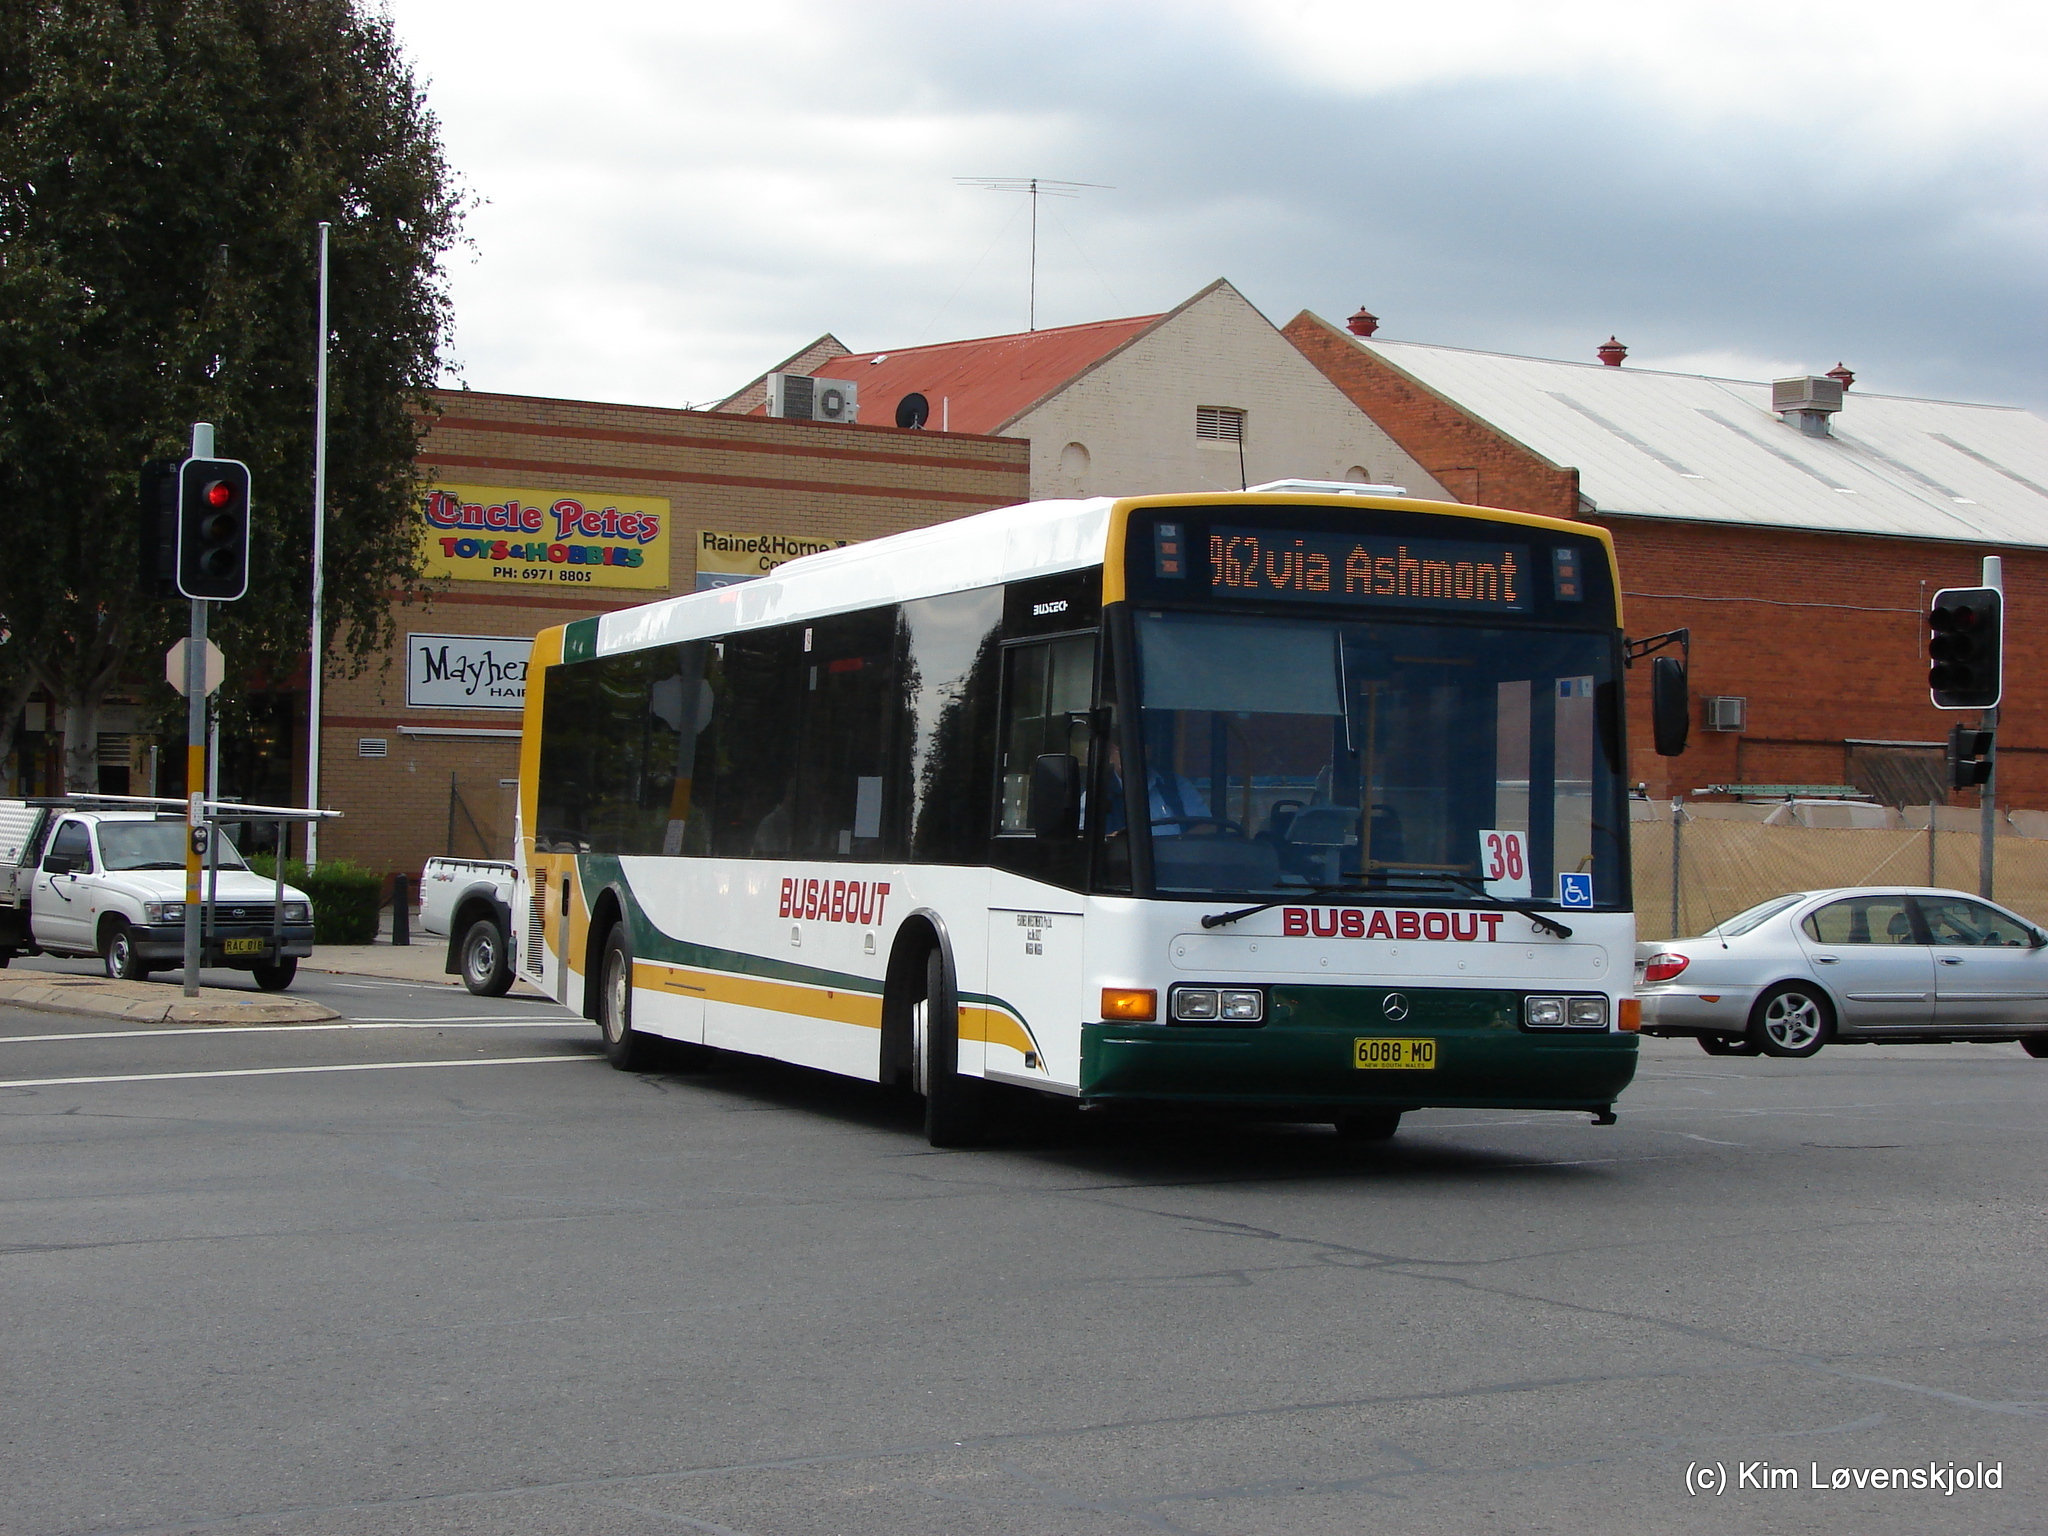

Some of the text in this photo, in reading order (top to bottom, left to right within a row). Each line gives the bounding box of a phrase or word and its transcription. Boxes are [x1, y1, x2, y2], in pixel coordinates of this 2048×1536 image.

[425, 491, 661, 545] Uncle Pete's
[439, 537, 645, 568] TOYS&HOBBIES
[1210, 535, 1517, 602] 962 via Ashmont
[492, 566, 592, 582] PH: 6971 8805
[1487, 834, 1523, 880] 38
[779, 877, 890, 926] BUSABOUT
[1283, 908, 1504, 942] BUSABOUT
[226, 940, 244, 951] RAC
